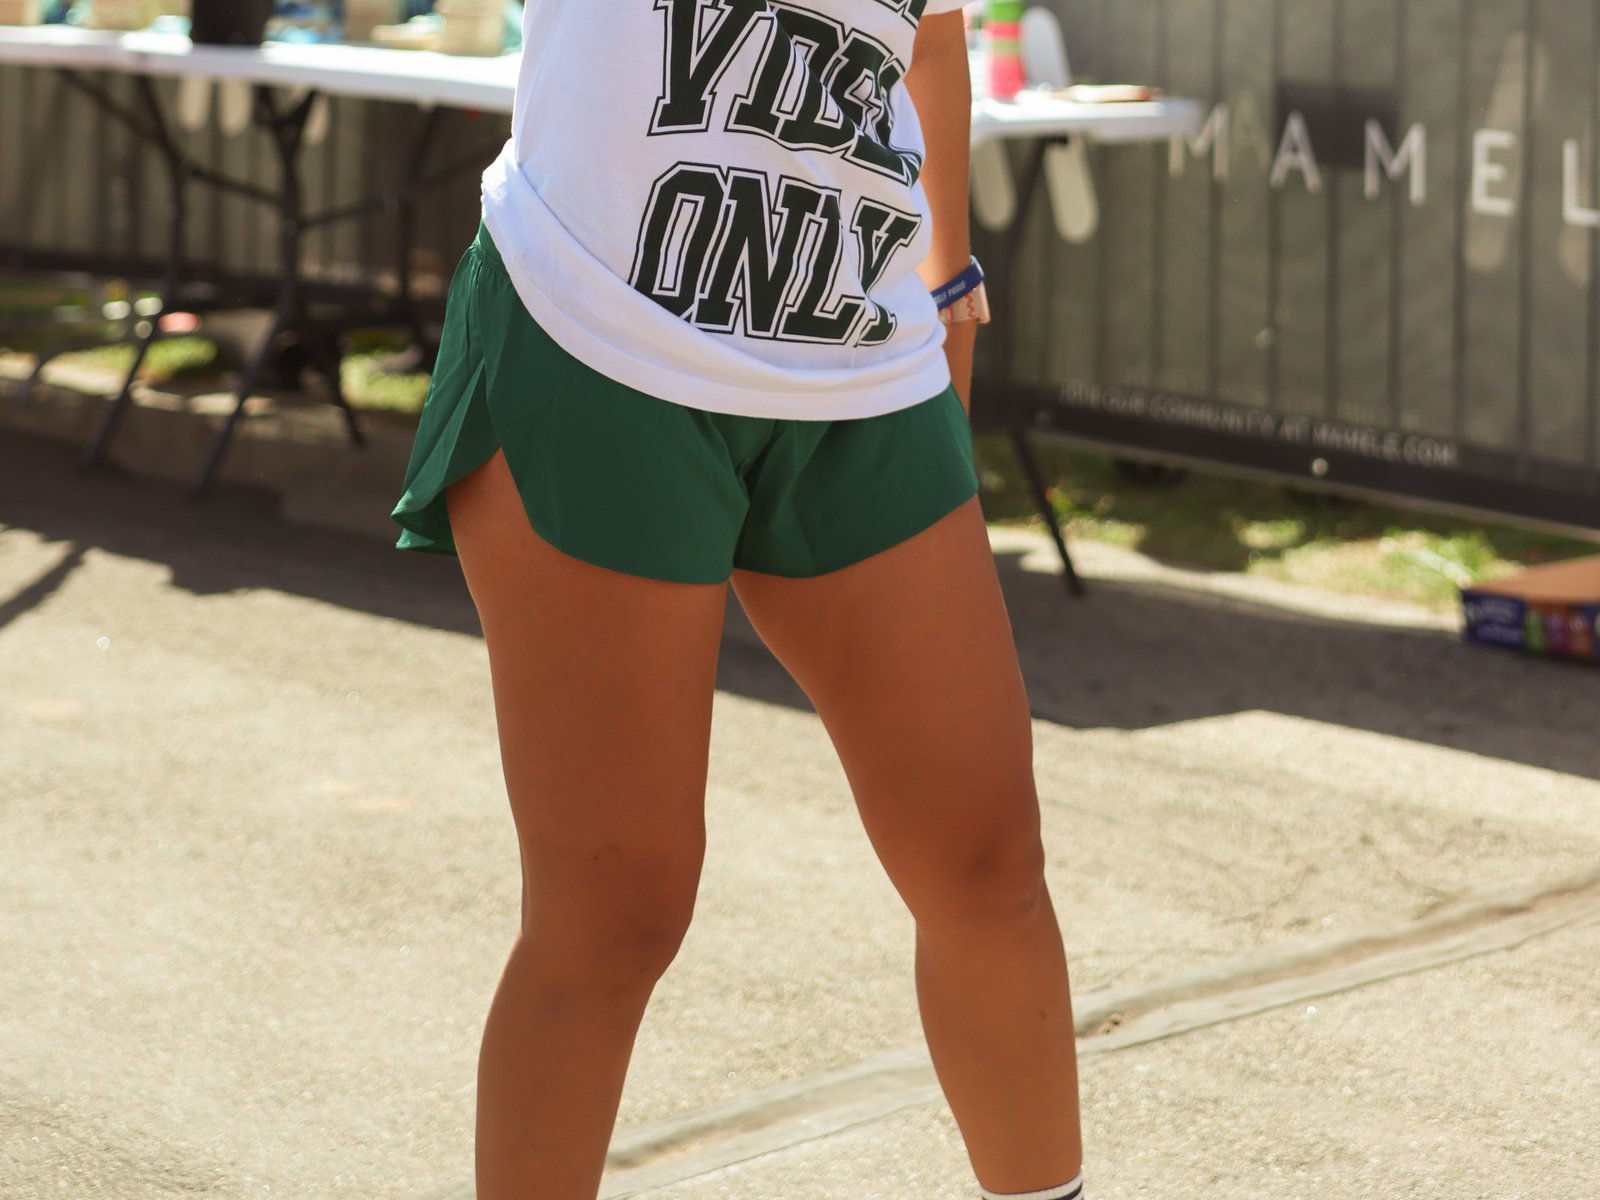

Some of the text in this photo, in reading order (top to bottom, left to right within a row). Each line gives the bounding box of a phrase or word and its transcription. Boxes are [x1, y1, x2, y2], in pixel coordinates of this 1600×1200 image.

[1168, 103, 1600, 227] MAMEL
[627, 162, 922, 347] ONLY
[1150, 393, 1275, 440] COMMUNITY
